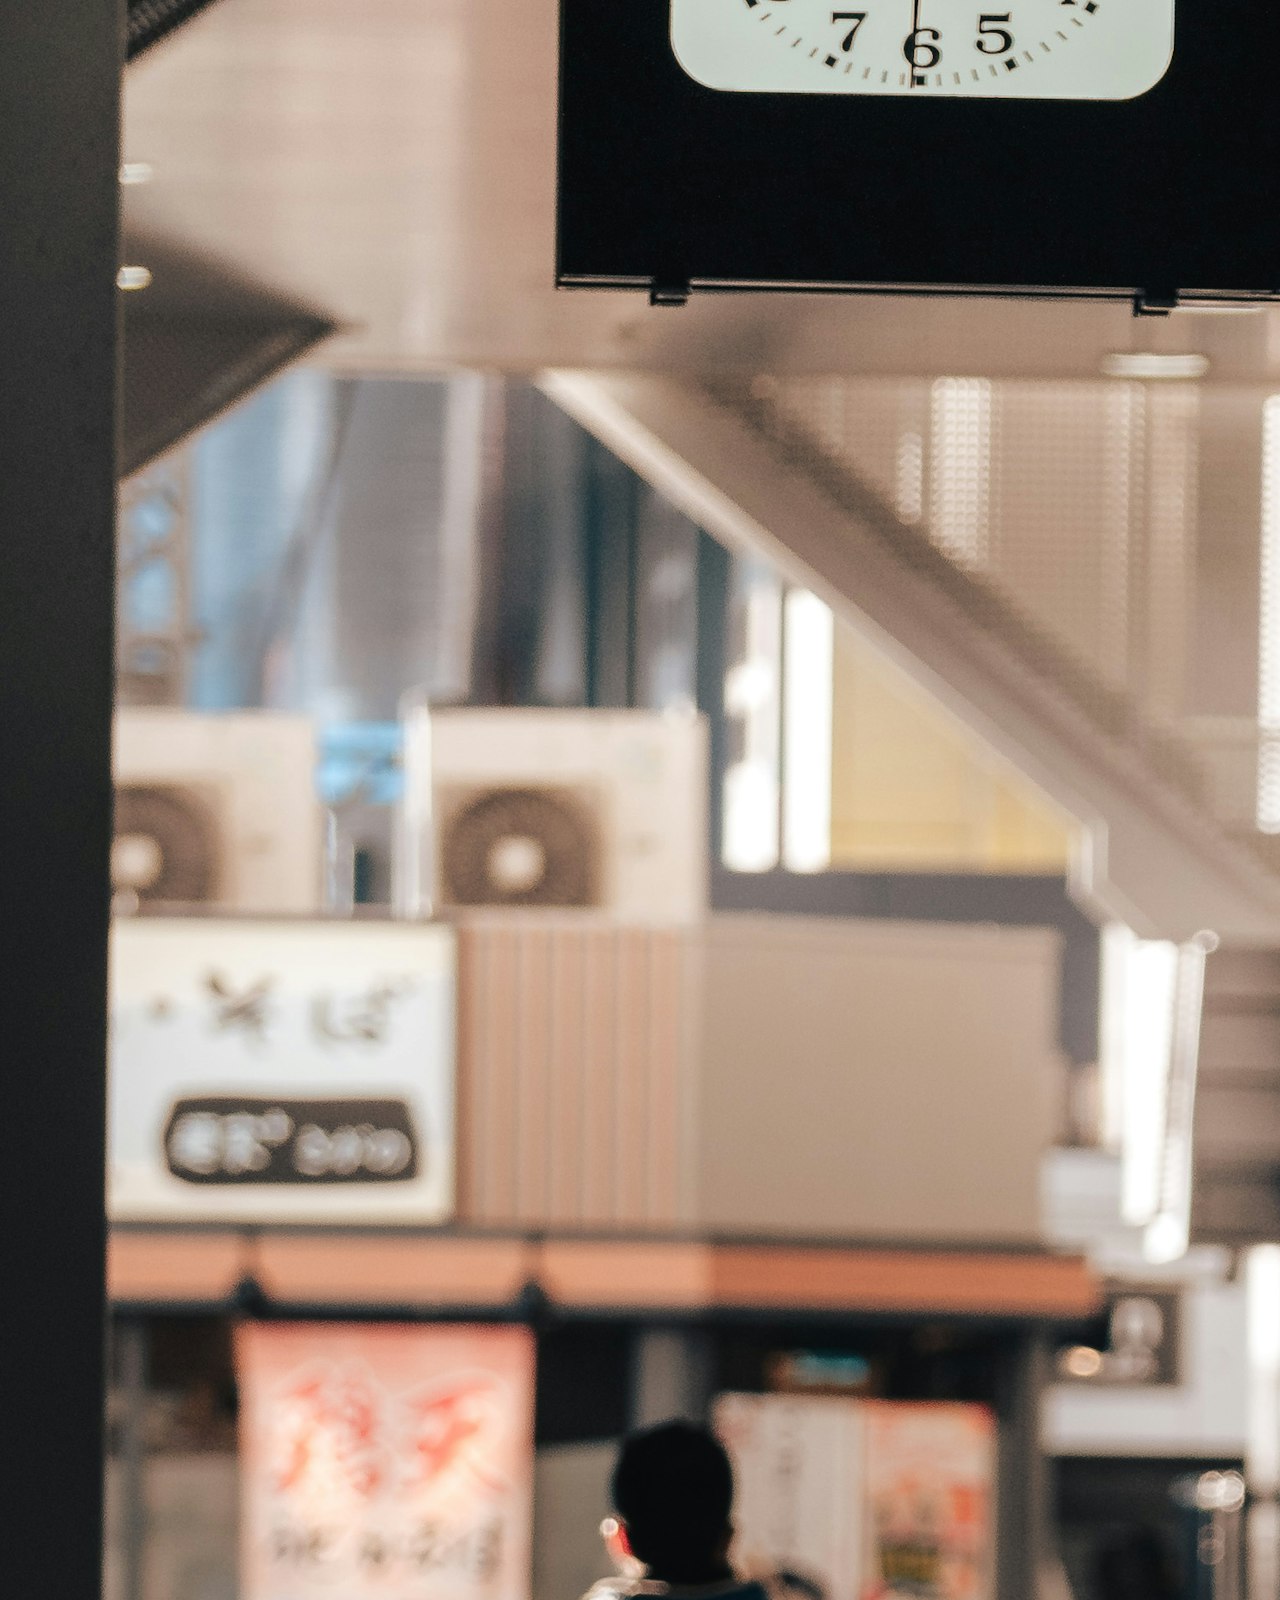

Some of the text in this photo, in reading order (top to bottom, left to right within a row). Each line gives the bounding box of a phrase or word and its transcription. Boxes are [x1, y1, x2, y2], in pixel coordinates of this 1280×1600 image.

[831, 12, 867, 52] 7
[904, 28, 941, 68] 6
[976, 14, 1012, 54] 5
